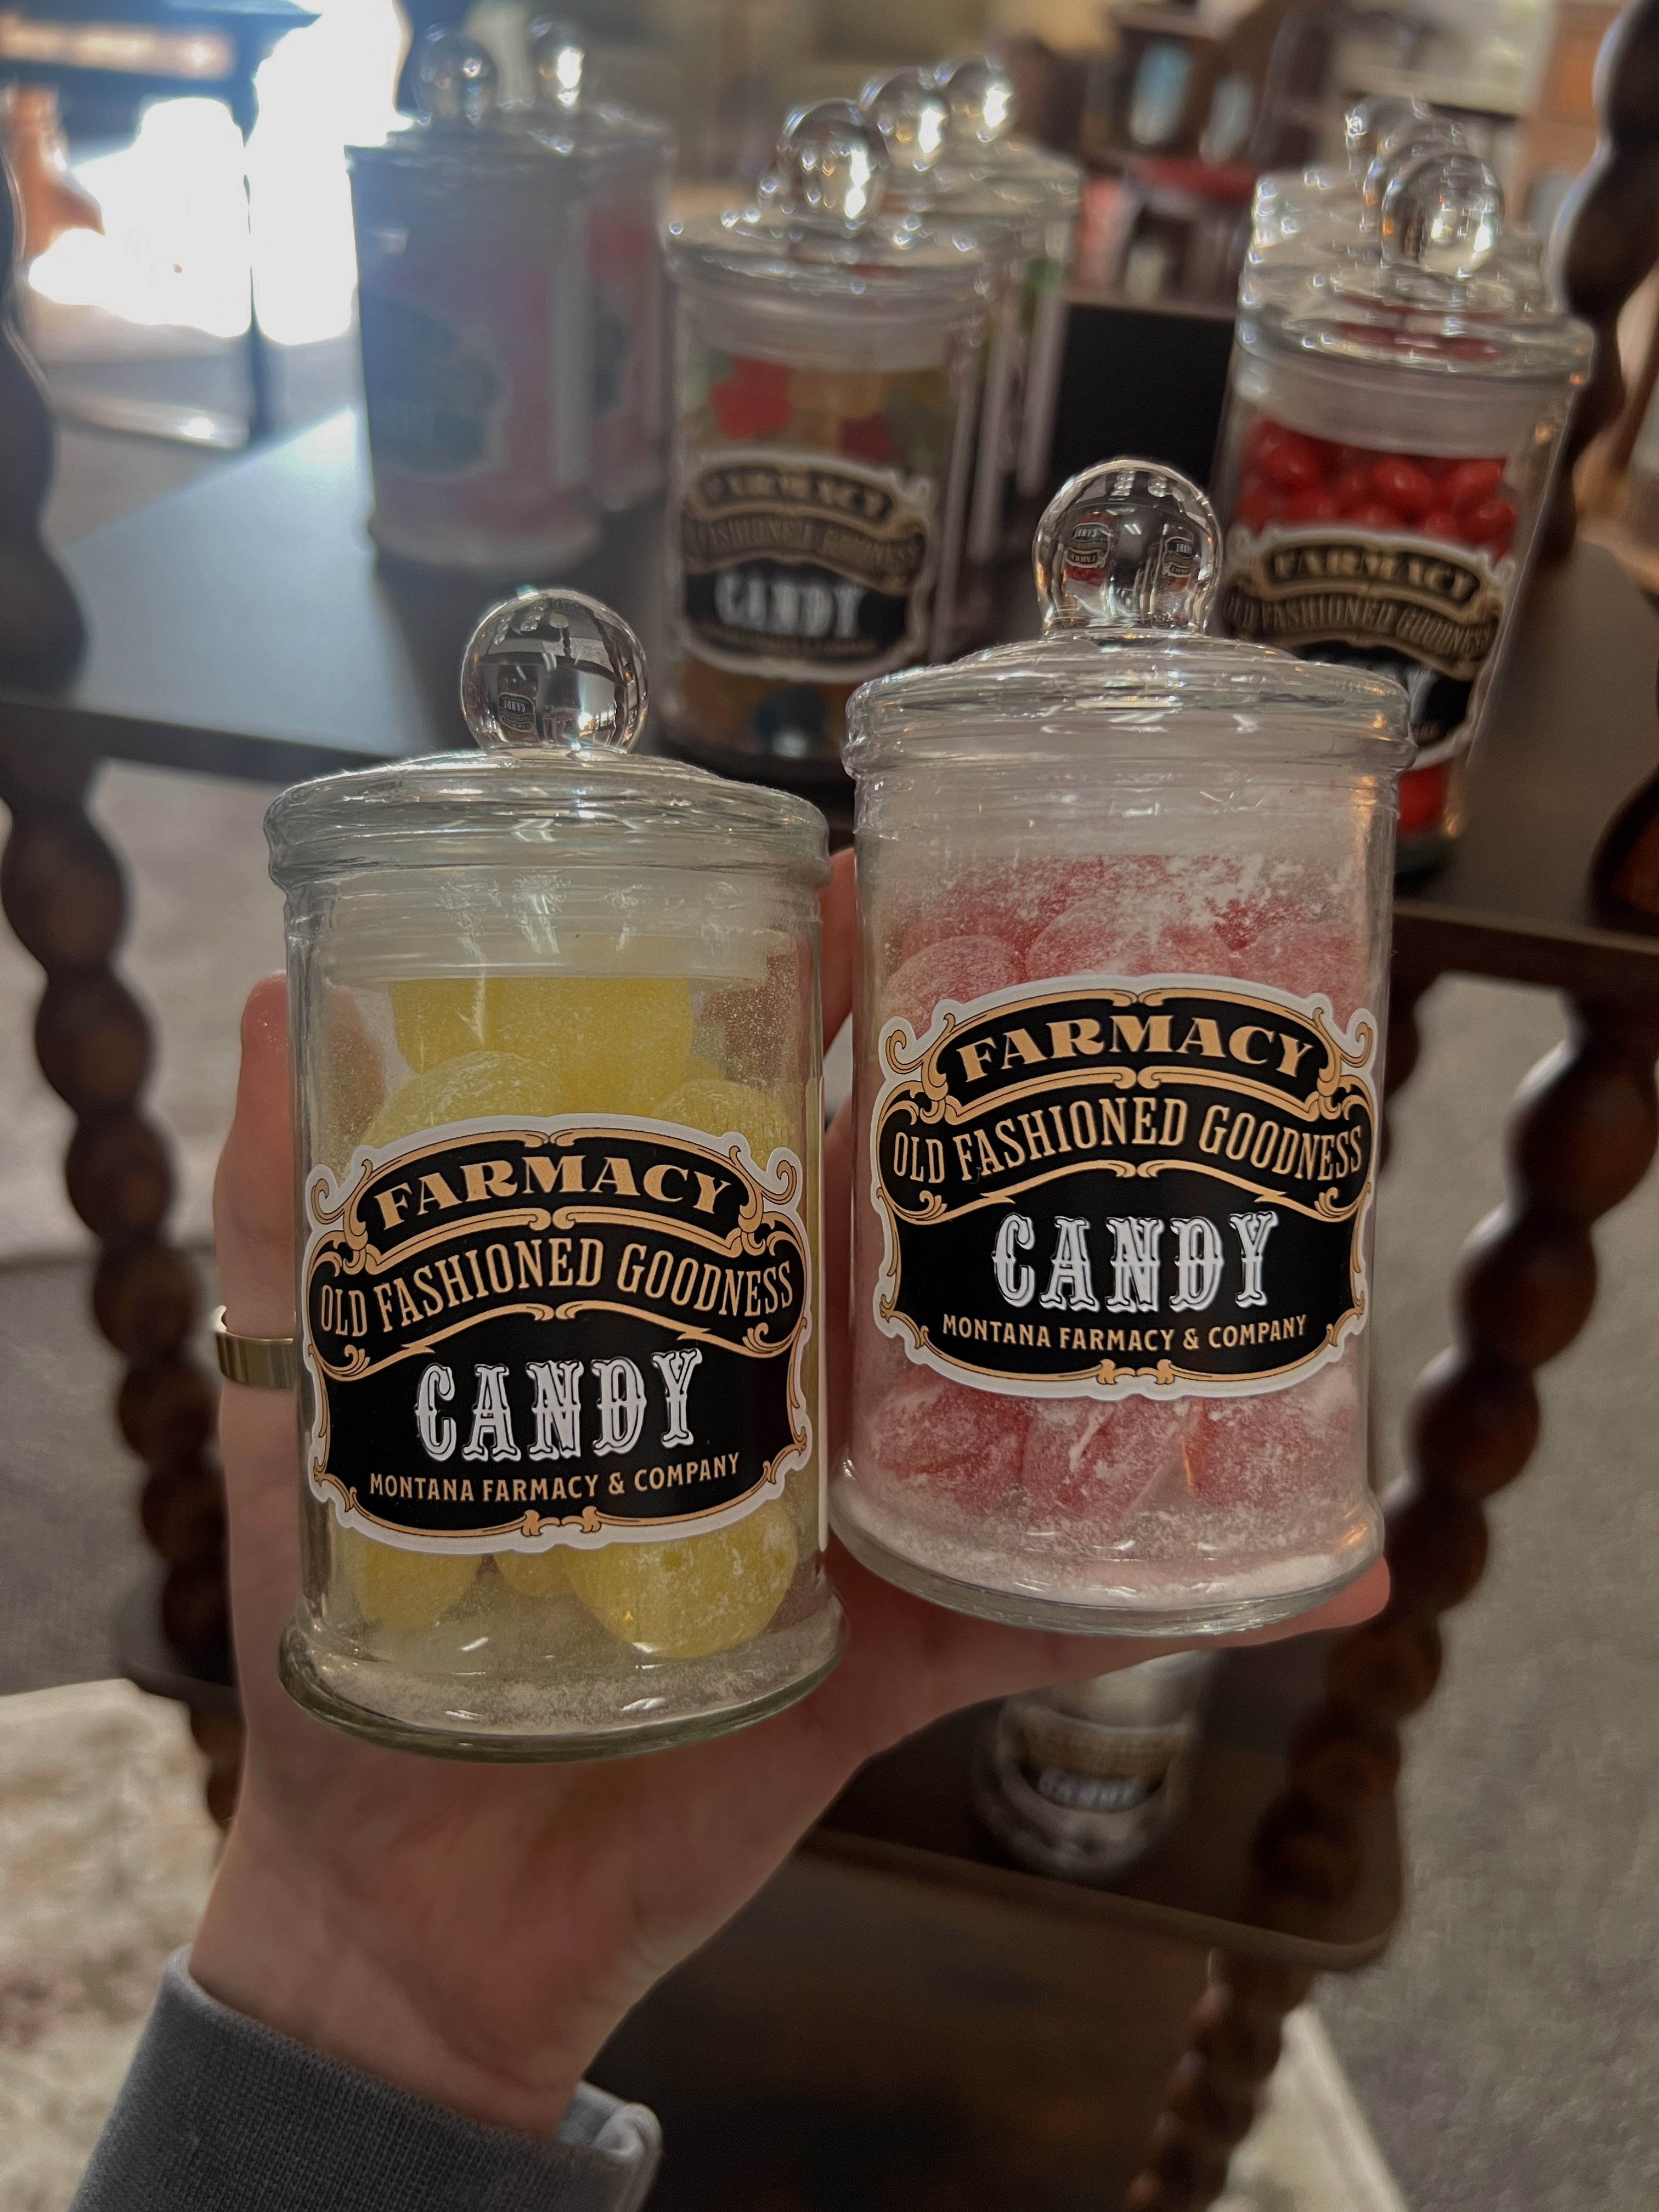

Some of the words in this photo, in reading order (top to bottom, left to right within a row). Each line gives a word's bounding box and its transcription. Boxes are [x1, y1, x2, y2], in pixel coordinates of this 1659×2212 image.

[1274, 550, 1474, 599] FARMACY
[956, 1014, 1314, 1084] FARMACY
[894, 1131, 945, 1184] OLD
[953, 1097, 1189, 1183] FASHIONED
[1199, 1105, 1363, 1181] GOODNESS
[374, 1155, 731, 1230] FARMACY
[321, 1284, 366, 1338] OLD
[376, 1239, 605, 1332] FASHIONED
[618, 1242, 794, 1317] GOODNESS
[992, 1211, 1279, 1313] CANDY
[943, 1313, 1052, 1348] MONTANA
[1059, 1327, 1175, 1351] FARMACY
[1183, 1329, 1199, 1350] &
[1209, 1314, 1307, 1348] COMPANY
[415, 1347, 703, 1462] CANDY
[370, 1473, 475, 1502] MONTANA
[483, 1479, 598, 1503] FARMACY
[608, 1477, 624, 1495] &
[635, 1452, 740, 1493] COMPANY
